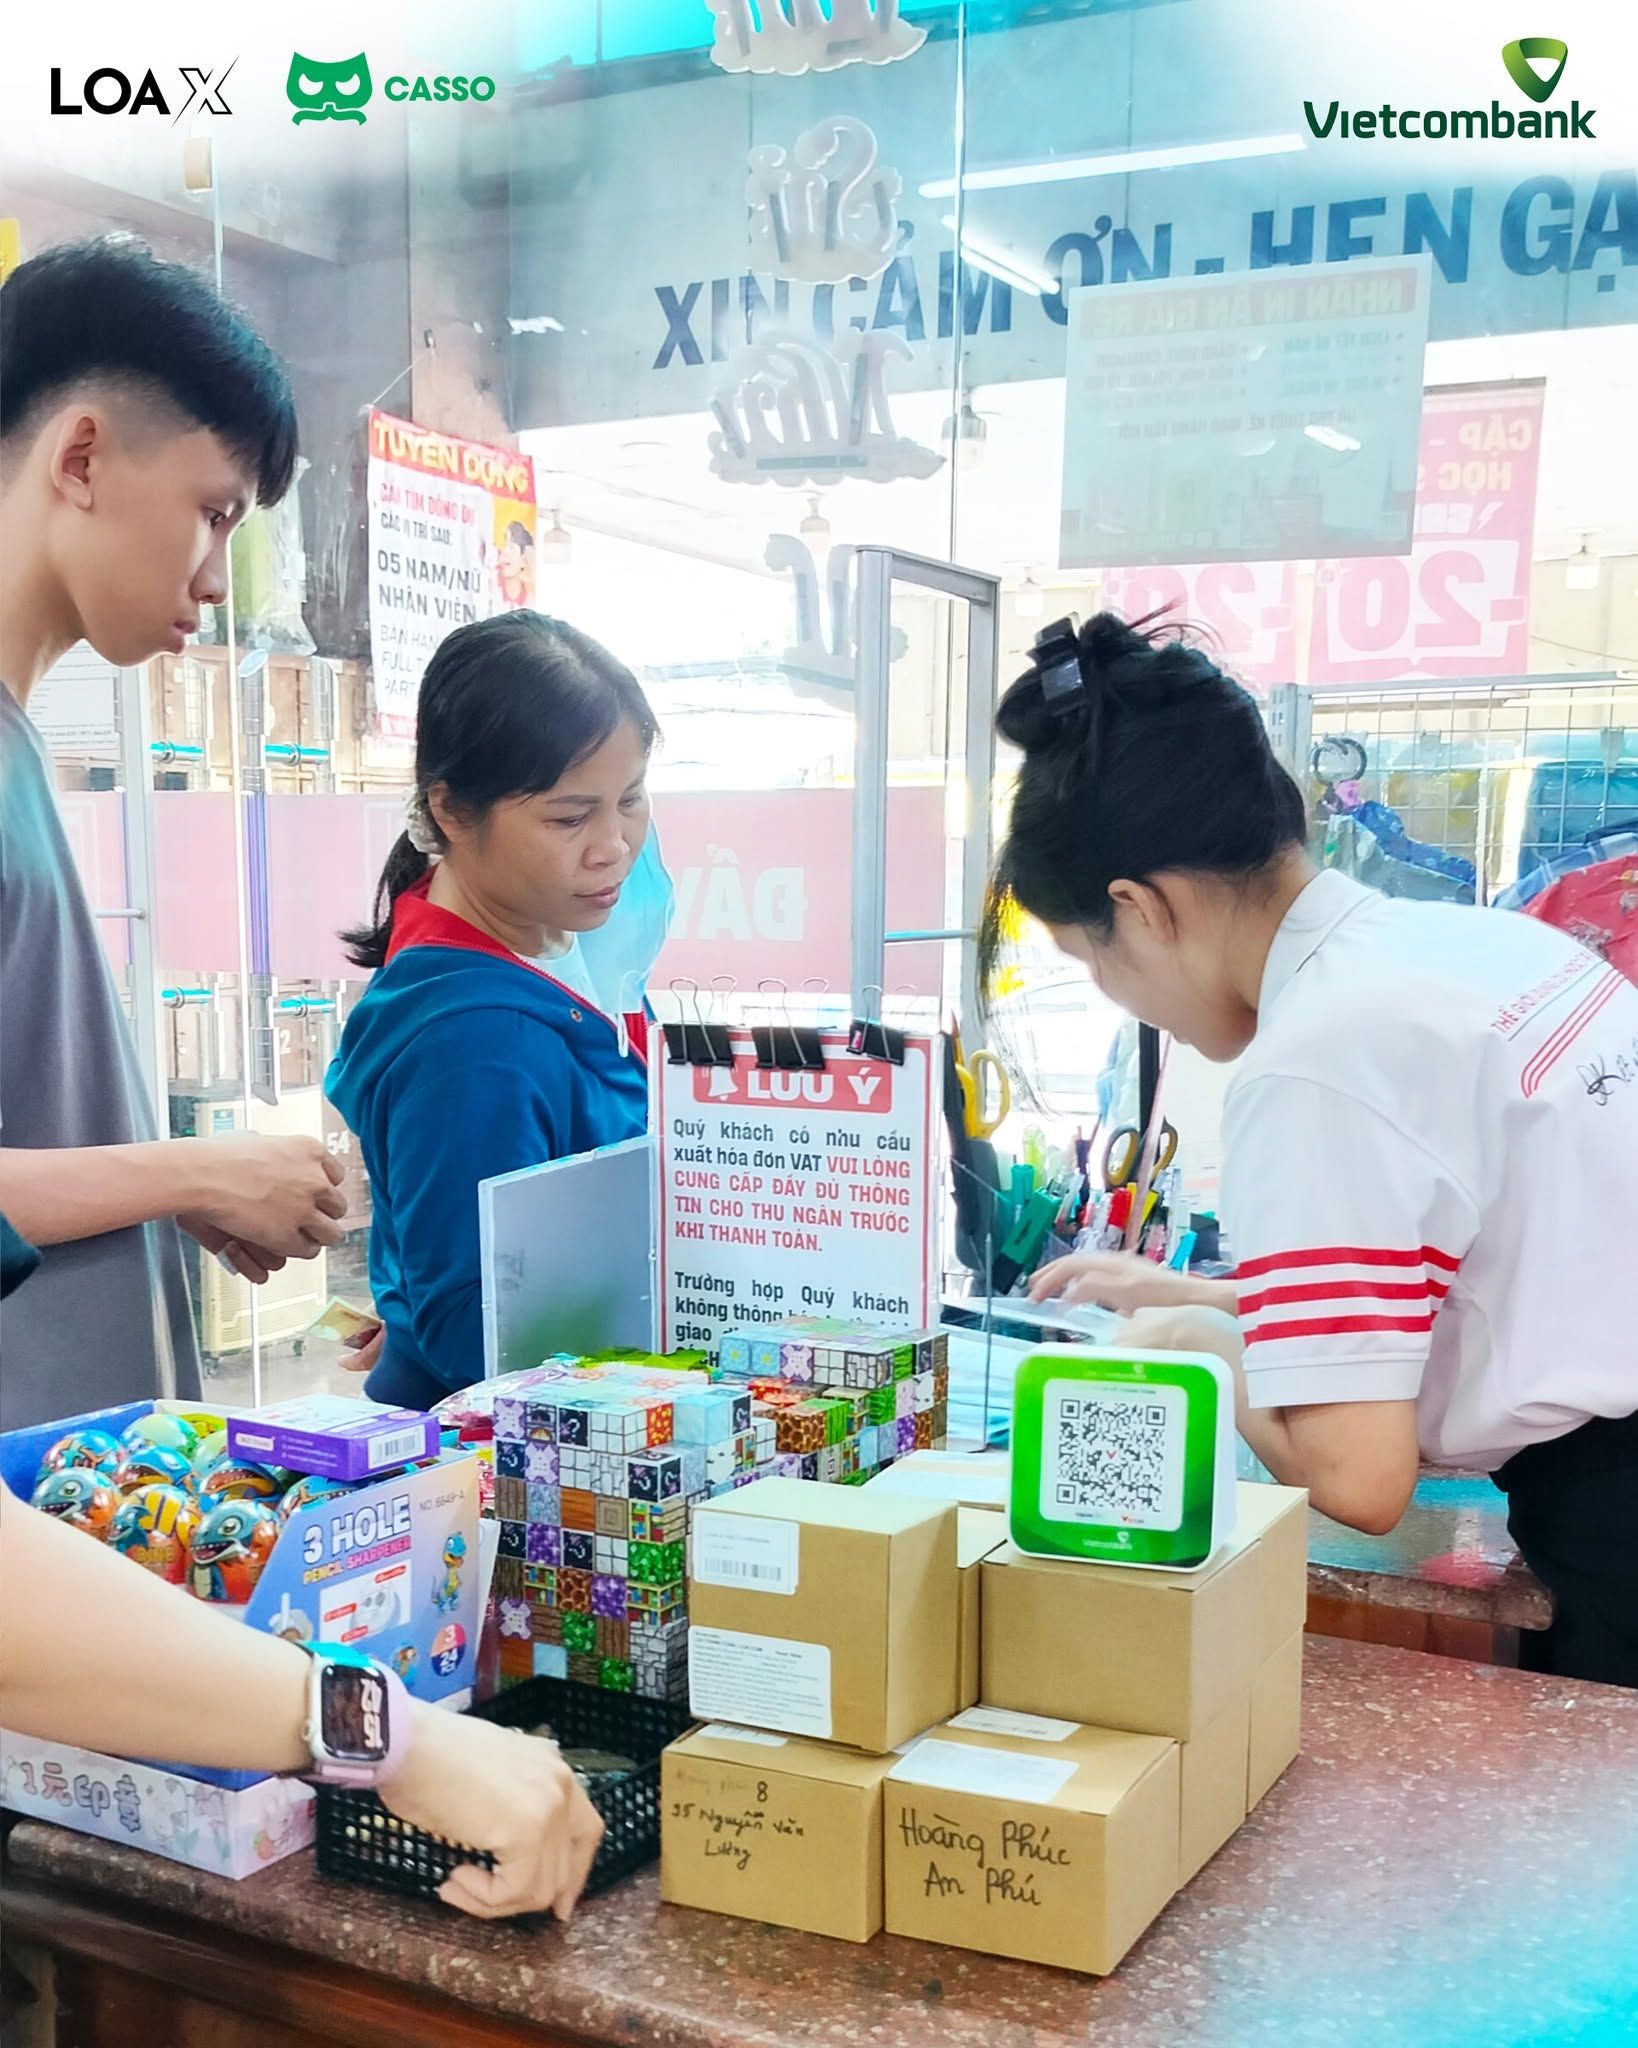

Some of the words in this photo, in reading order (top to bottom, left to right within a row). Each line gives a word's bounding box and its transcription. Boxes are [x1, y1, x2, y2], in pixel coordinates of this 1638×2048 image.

[652, 274, 790, 369] XIN
[377, 549, 401, 575] 05
[378, 583, 427, 616] NHÂN
[847, 1067, 882, 1105] Ý
[673, 1118, 706, 1140] Quý
[720, 1121, 774, 1142] khách
[789, 1125, 810, 1144] có
[673, 1144, 712, 1164] xuất
[717, 1147, 748, 1167] hóa
[753, 1150, 786, 1170] đơn
[790, 1153, 822, 1172] VAT
[826, 1155, 858, 1176] VUI
[862, 1155, 911, 1179] LÒNG
[674, 1170, 720, 1190] CUNG
[729, 1171, 763, 1193] CẤP
[815, 1178, 840, 1200] ĐỦ
[848, 1181, 911, 1206] THÔNG
[674, 1195, 702, 1214] TIN
[709, 1199, 744, 1218] CHO
[751, 1202, 785, 1222] THU
[792, 1204, 842, 1227] NGÂN
[850, 1209, 911, 1234] TRƯỚC
[675, 1220, 705, 1240] KHI
[709, 1224, 767, 1246] THANH
[771, 1227, 824, 1252] TOÁN.
[674, 1271, 735, 1298] Trường
[751, 1279, 784, 1303] hợp
[801, 1285, 835, 1309] Quý
[852, 1290, 910, 1315] khách
[675, 1296, 728, 1322] không
[675, 1321, 712, 1342] giao
[303, 1524, 324, 1566] 3
[331, 1493, 412, 1558] HOLE
[757, 1780, 769, 1803] 8
[899, 1807, 985, 1869] Hoàng
[1001, 1820, 1072, 1866] Phúc
[923, 1860, 965, 1898] An
[985, 1867, 1042, 1906] Phú
